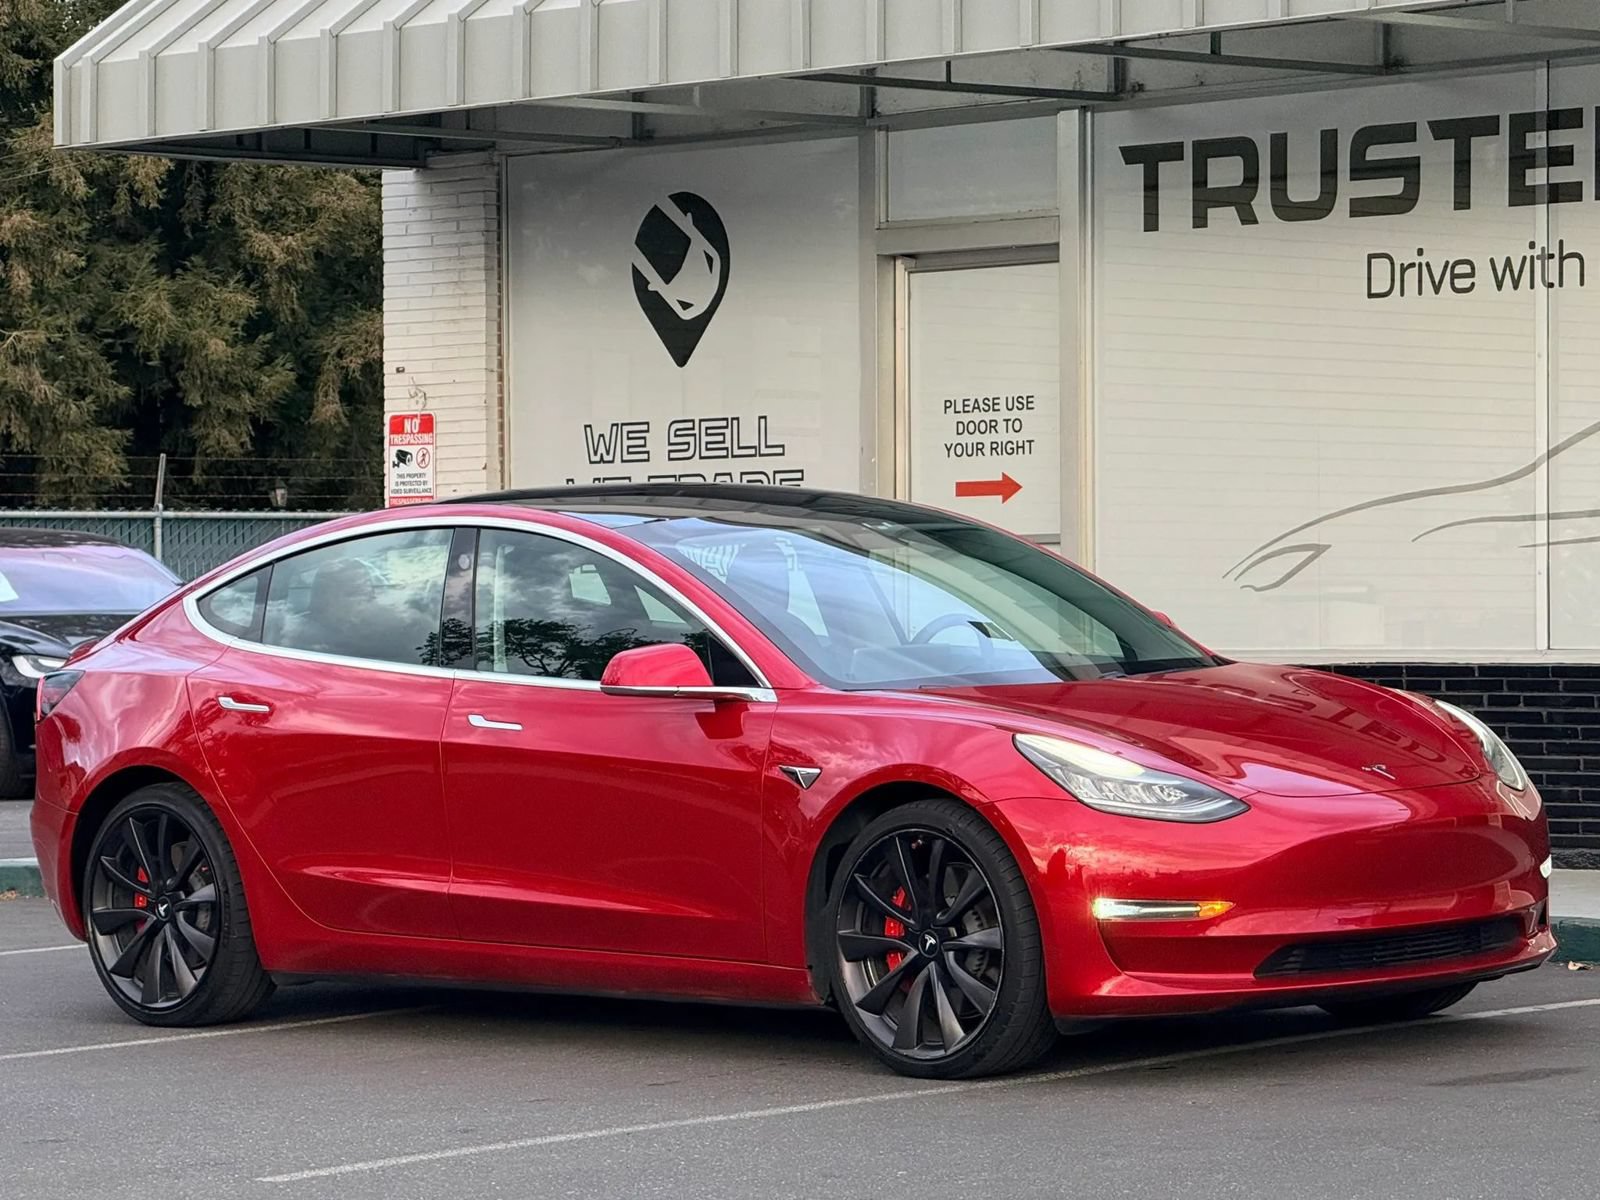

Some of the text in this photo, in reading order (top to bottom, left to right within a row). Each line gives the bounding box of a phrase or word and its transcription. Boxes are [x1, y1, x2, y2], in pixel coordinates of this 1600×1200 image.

[1118, 106, 1600, 232] TRUSTE
[1367, 239, 1585, 299] Drive with
[944, 395, 1035, 414] PLEASE USE
[404, 418, 419, 433] NO
[956, 418, 1023, 435] DOOR TO
[390, 433, 433, 445] TRESPASSING
[584, 415, 785, 464] WE SELL
[944, 440, 1035, 458] YOUR RIGHT
